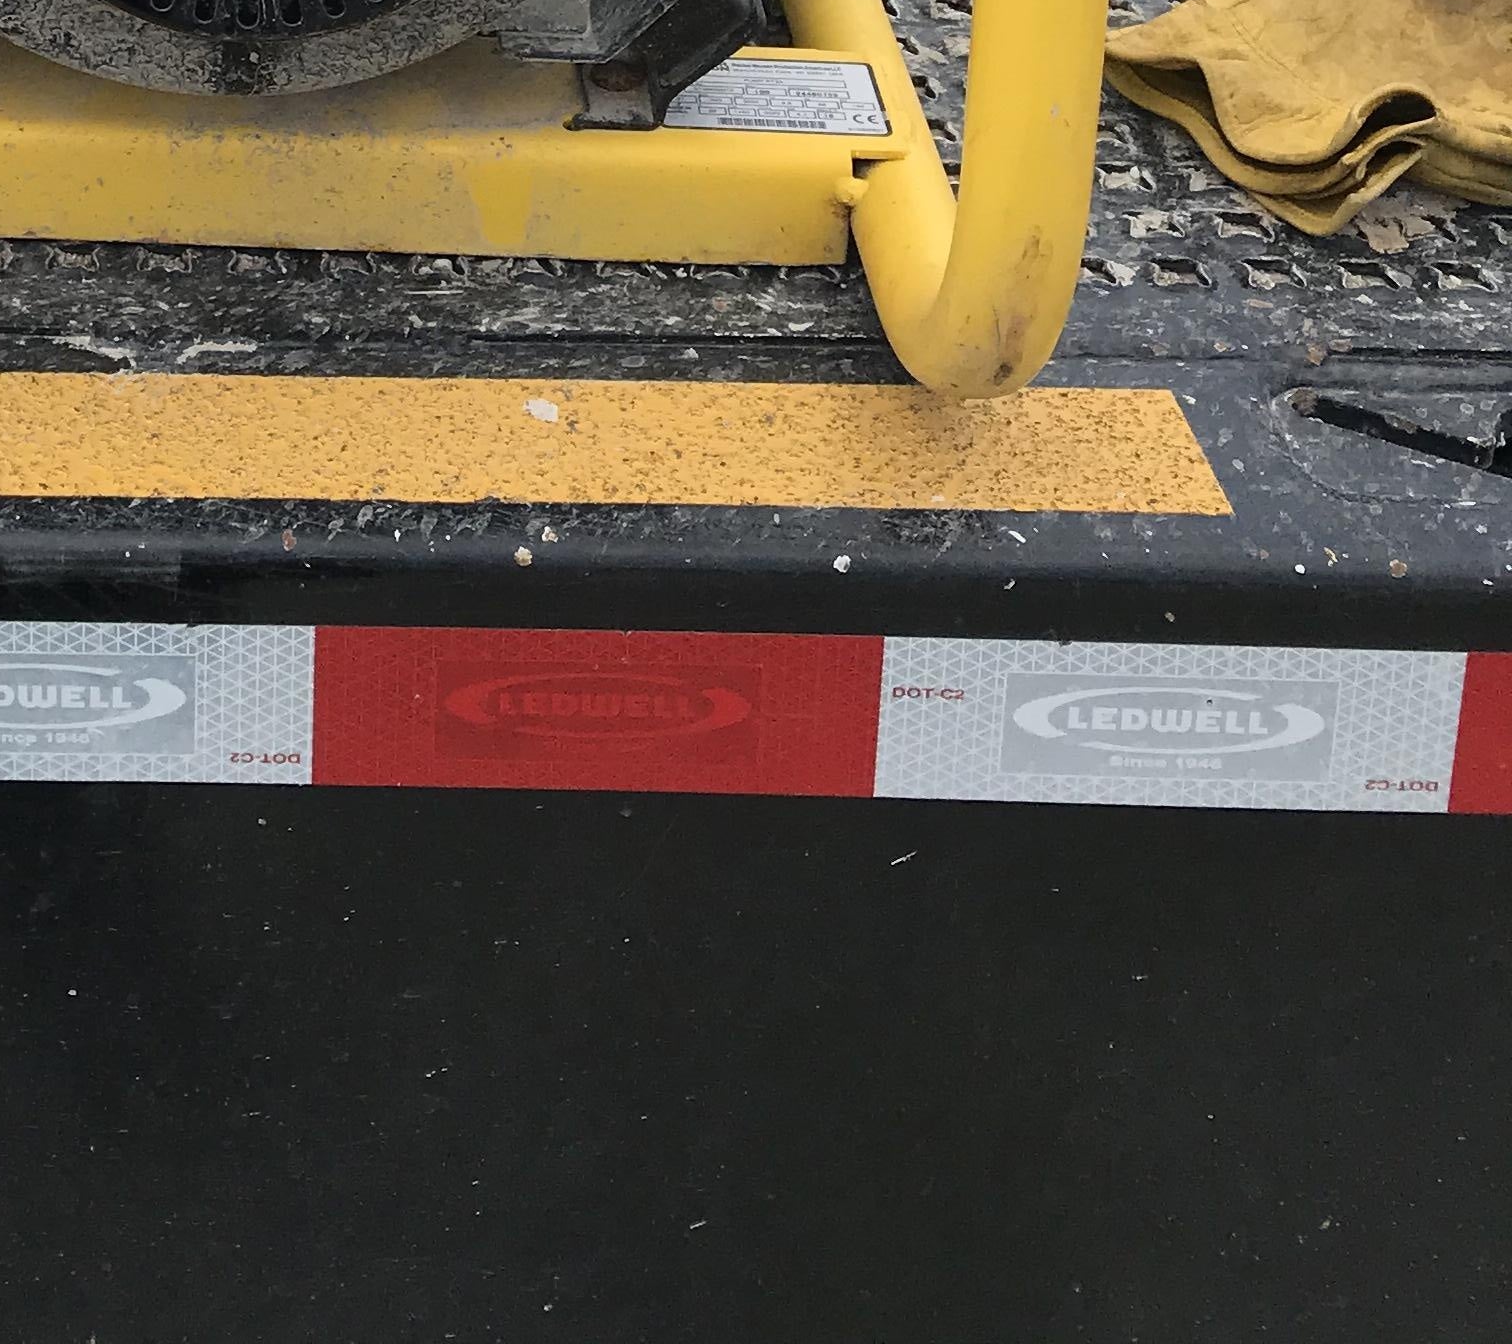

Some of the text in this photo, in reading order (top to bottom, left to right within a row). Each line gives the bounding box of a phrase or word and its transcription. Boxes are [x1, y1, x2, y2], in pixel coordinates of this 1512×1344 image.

[892, 686, 964, 700] DOT-C2
[499, 690, 696, 718] LEDWELL
[1067, 705, 1268, 735] LEDWELL
[230, 752, 301, 764] DOT-C2
[1110, 755, 1167, 768] Since
[1365, 778, 1438, 792] DOT-C2
